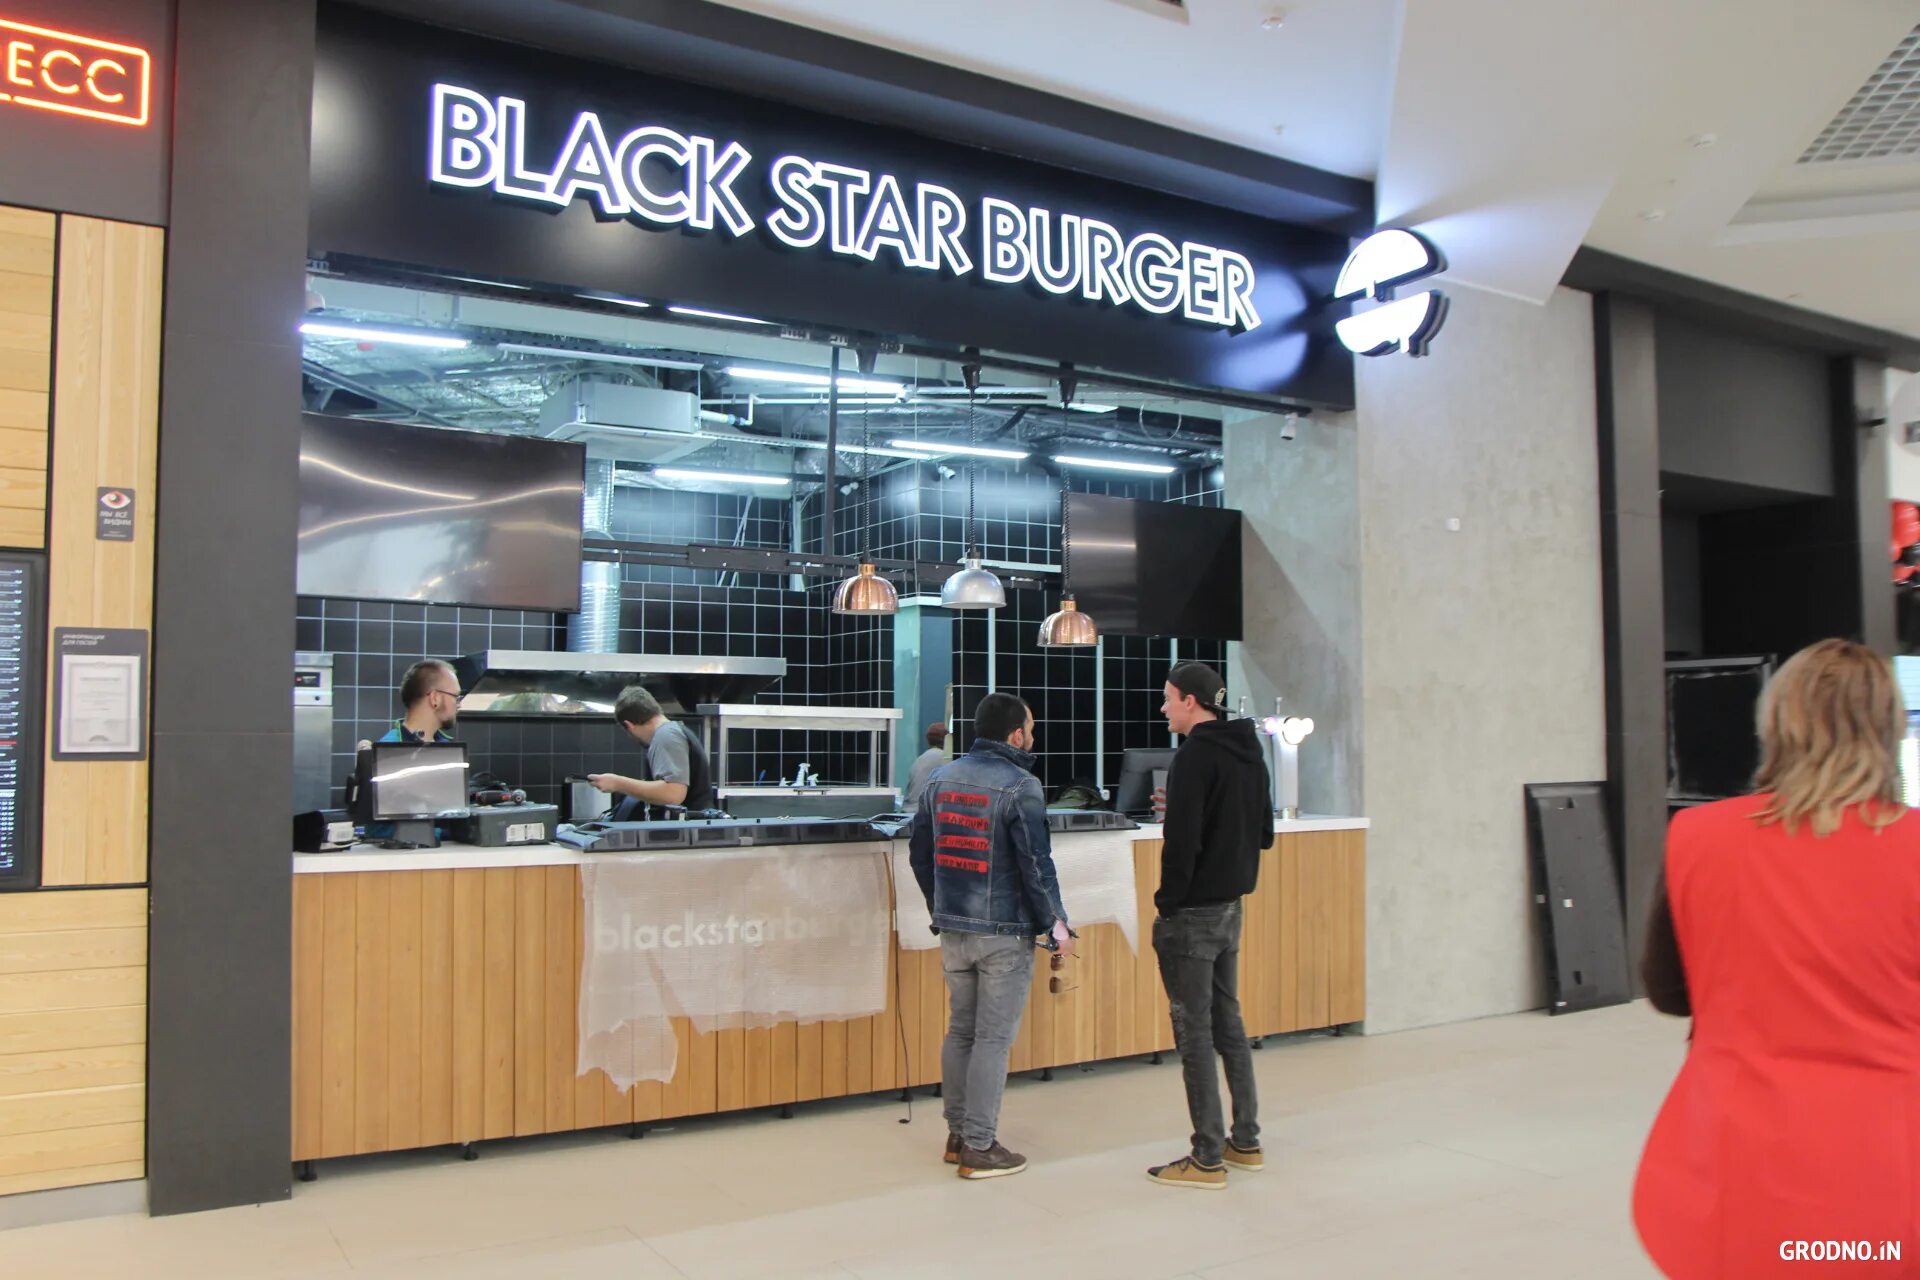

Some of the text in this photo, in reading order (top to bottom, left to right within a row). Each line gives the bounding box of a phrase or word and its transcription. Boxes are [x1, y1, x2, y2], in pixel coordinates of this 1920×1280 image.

[431, 83, 1262, 331] BLACK STAR BURGER
